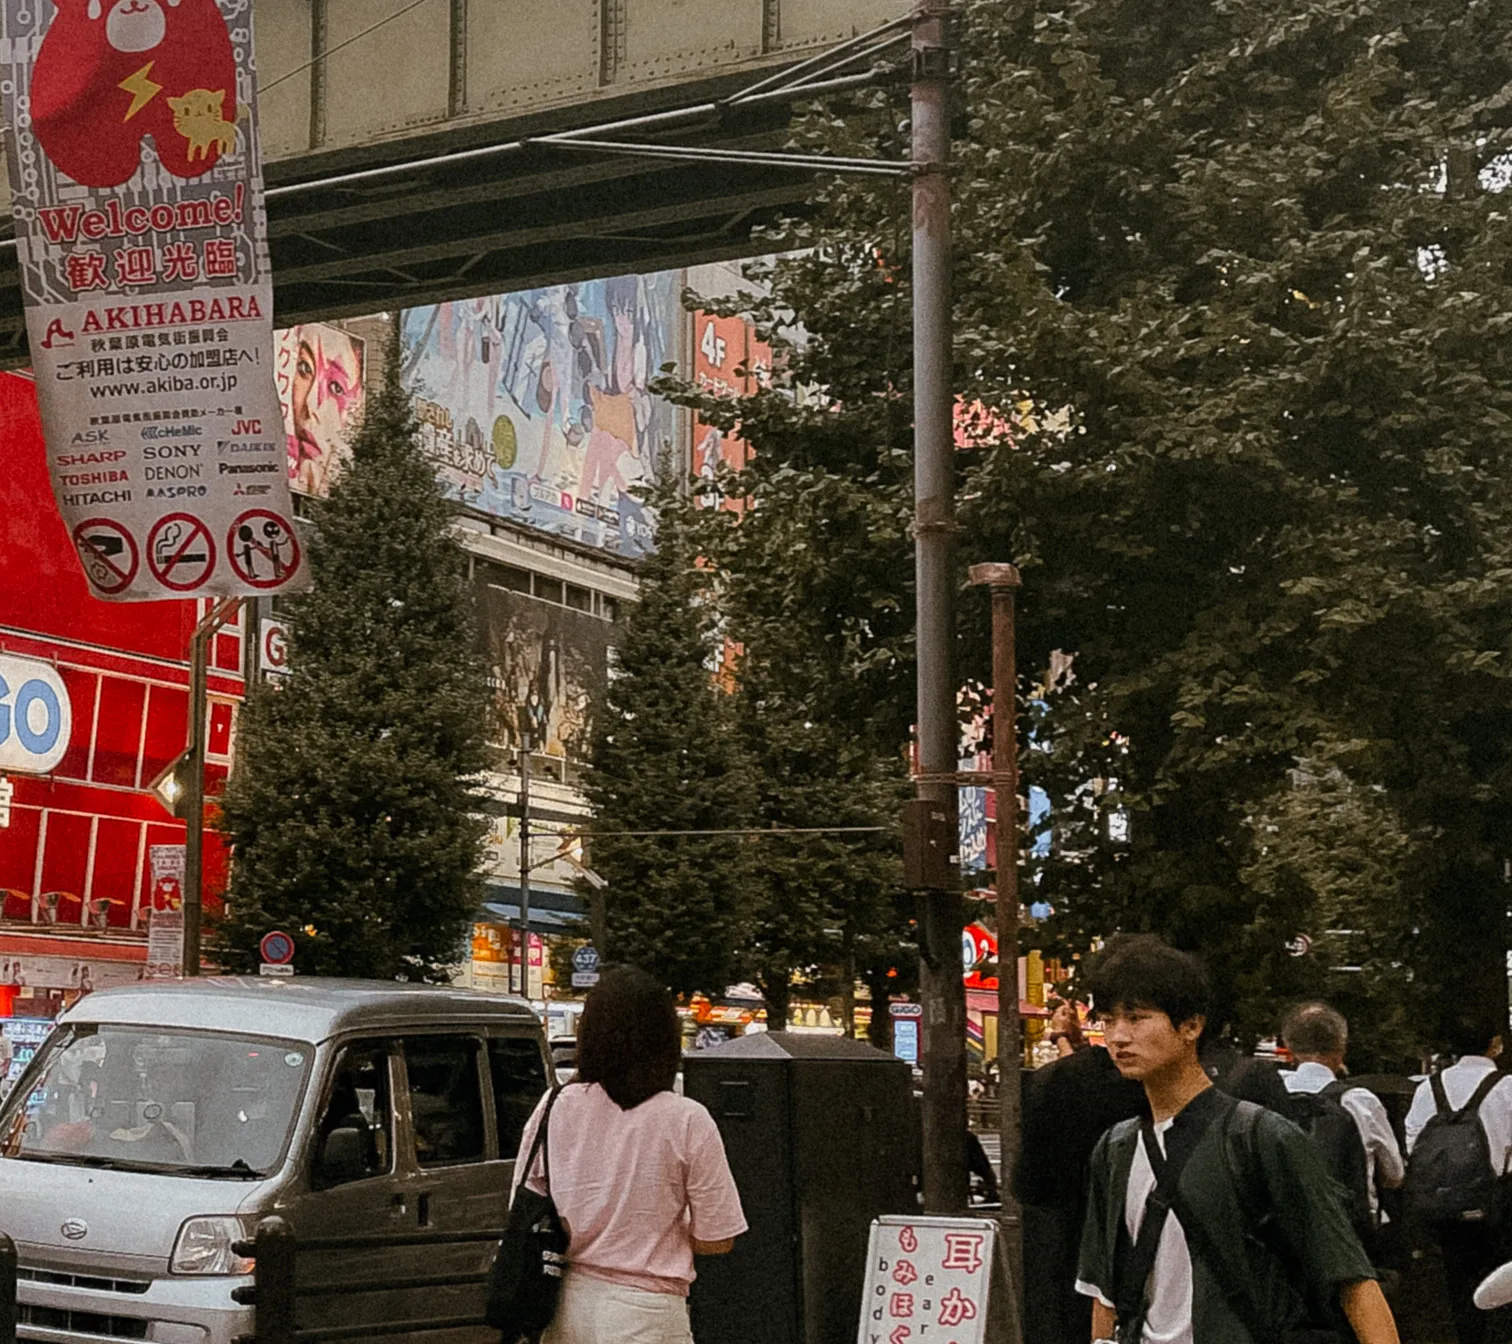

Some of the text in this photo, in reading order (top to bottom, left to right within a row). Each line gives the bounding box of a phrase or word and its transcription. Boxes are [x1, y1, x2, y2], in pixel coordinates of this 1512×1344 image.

[38, 183, 245, 243] Welcome!
[65, 240, 237, 290] 歓迎光臨
[82, 295, 262, 332] AKIHABARA
[56, 348, 260, 381] ご利用は安心の加盟店へ!
[90, 372, 237, 398] www.akiba.or.jp
[231, 420, 262, 435] JVC
[71, 429, 109, 444] ASK
[57, 451, 127, 467] SHARP
[143, 444, 202, 460] SONY
[144, 464, 202, 481] DENON
[218, 462, 280, 474] Panasonic
[59, 470, 129, 487] TOSHIBA
[62, 489, 132, 507] HITACHI
